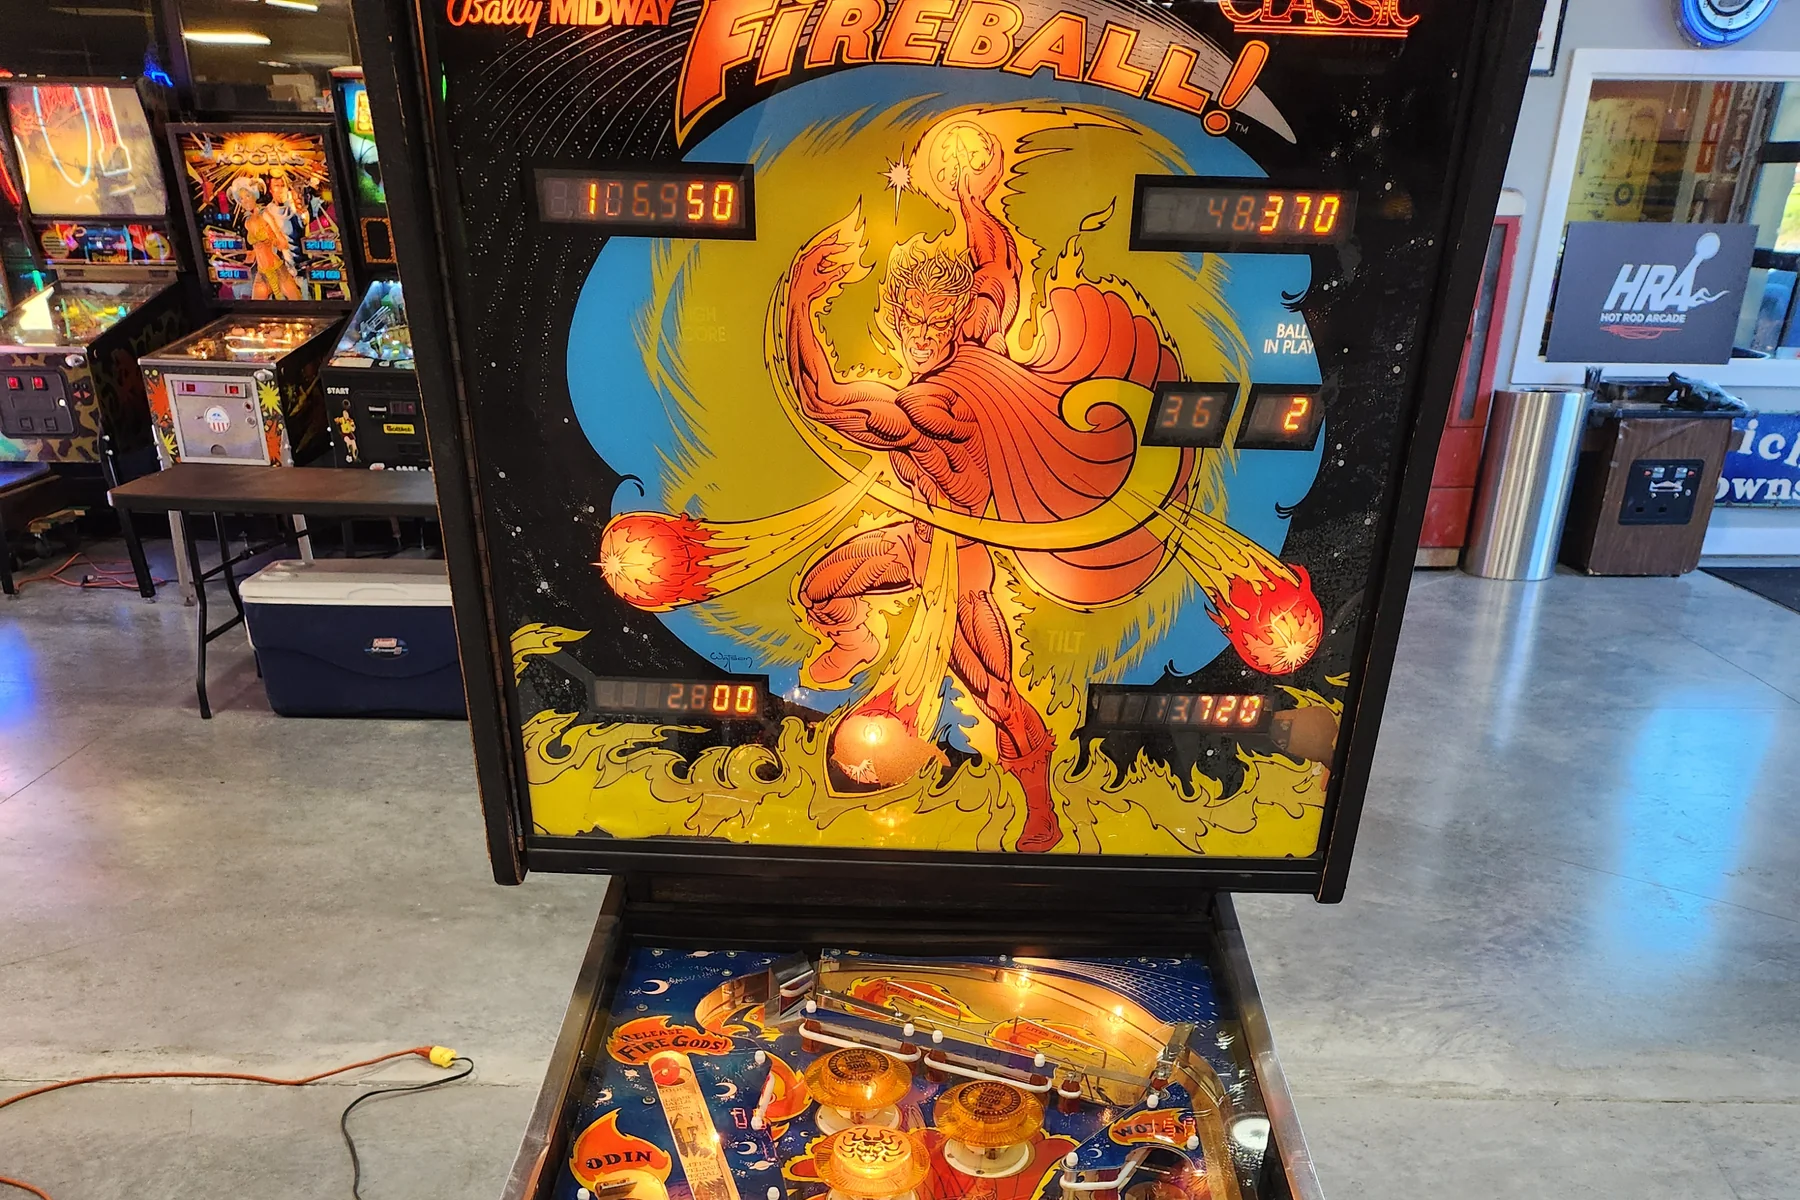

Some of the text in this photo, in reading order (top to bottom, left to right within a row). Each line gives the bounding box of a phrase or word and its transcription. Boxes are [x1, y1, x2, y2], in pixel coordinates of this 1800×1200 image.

[550, 0, 678, 25] MIDWAY
[1217, 0, 1419, 27] CLASSIC
[1600, 313, 1687, 324] HOT ROD ARCADE
[1276, 323, 1309, 339] BALL
[1264, 339, 1315, 355] IN PLAY
[327, 387, 350, 395] START
[1162, 396, 1214, 428] 36
[1284, 397, 1309, 431] 2
[1048, 630, 1085, 653] TILT
[621, 1029, 683, 1042] RELEASE
[617, 1038, 670, 1062] FIRE
[586, 1151, 653, 1169] ODIN
